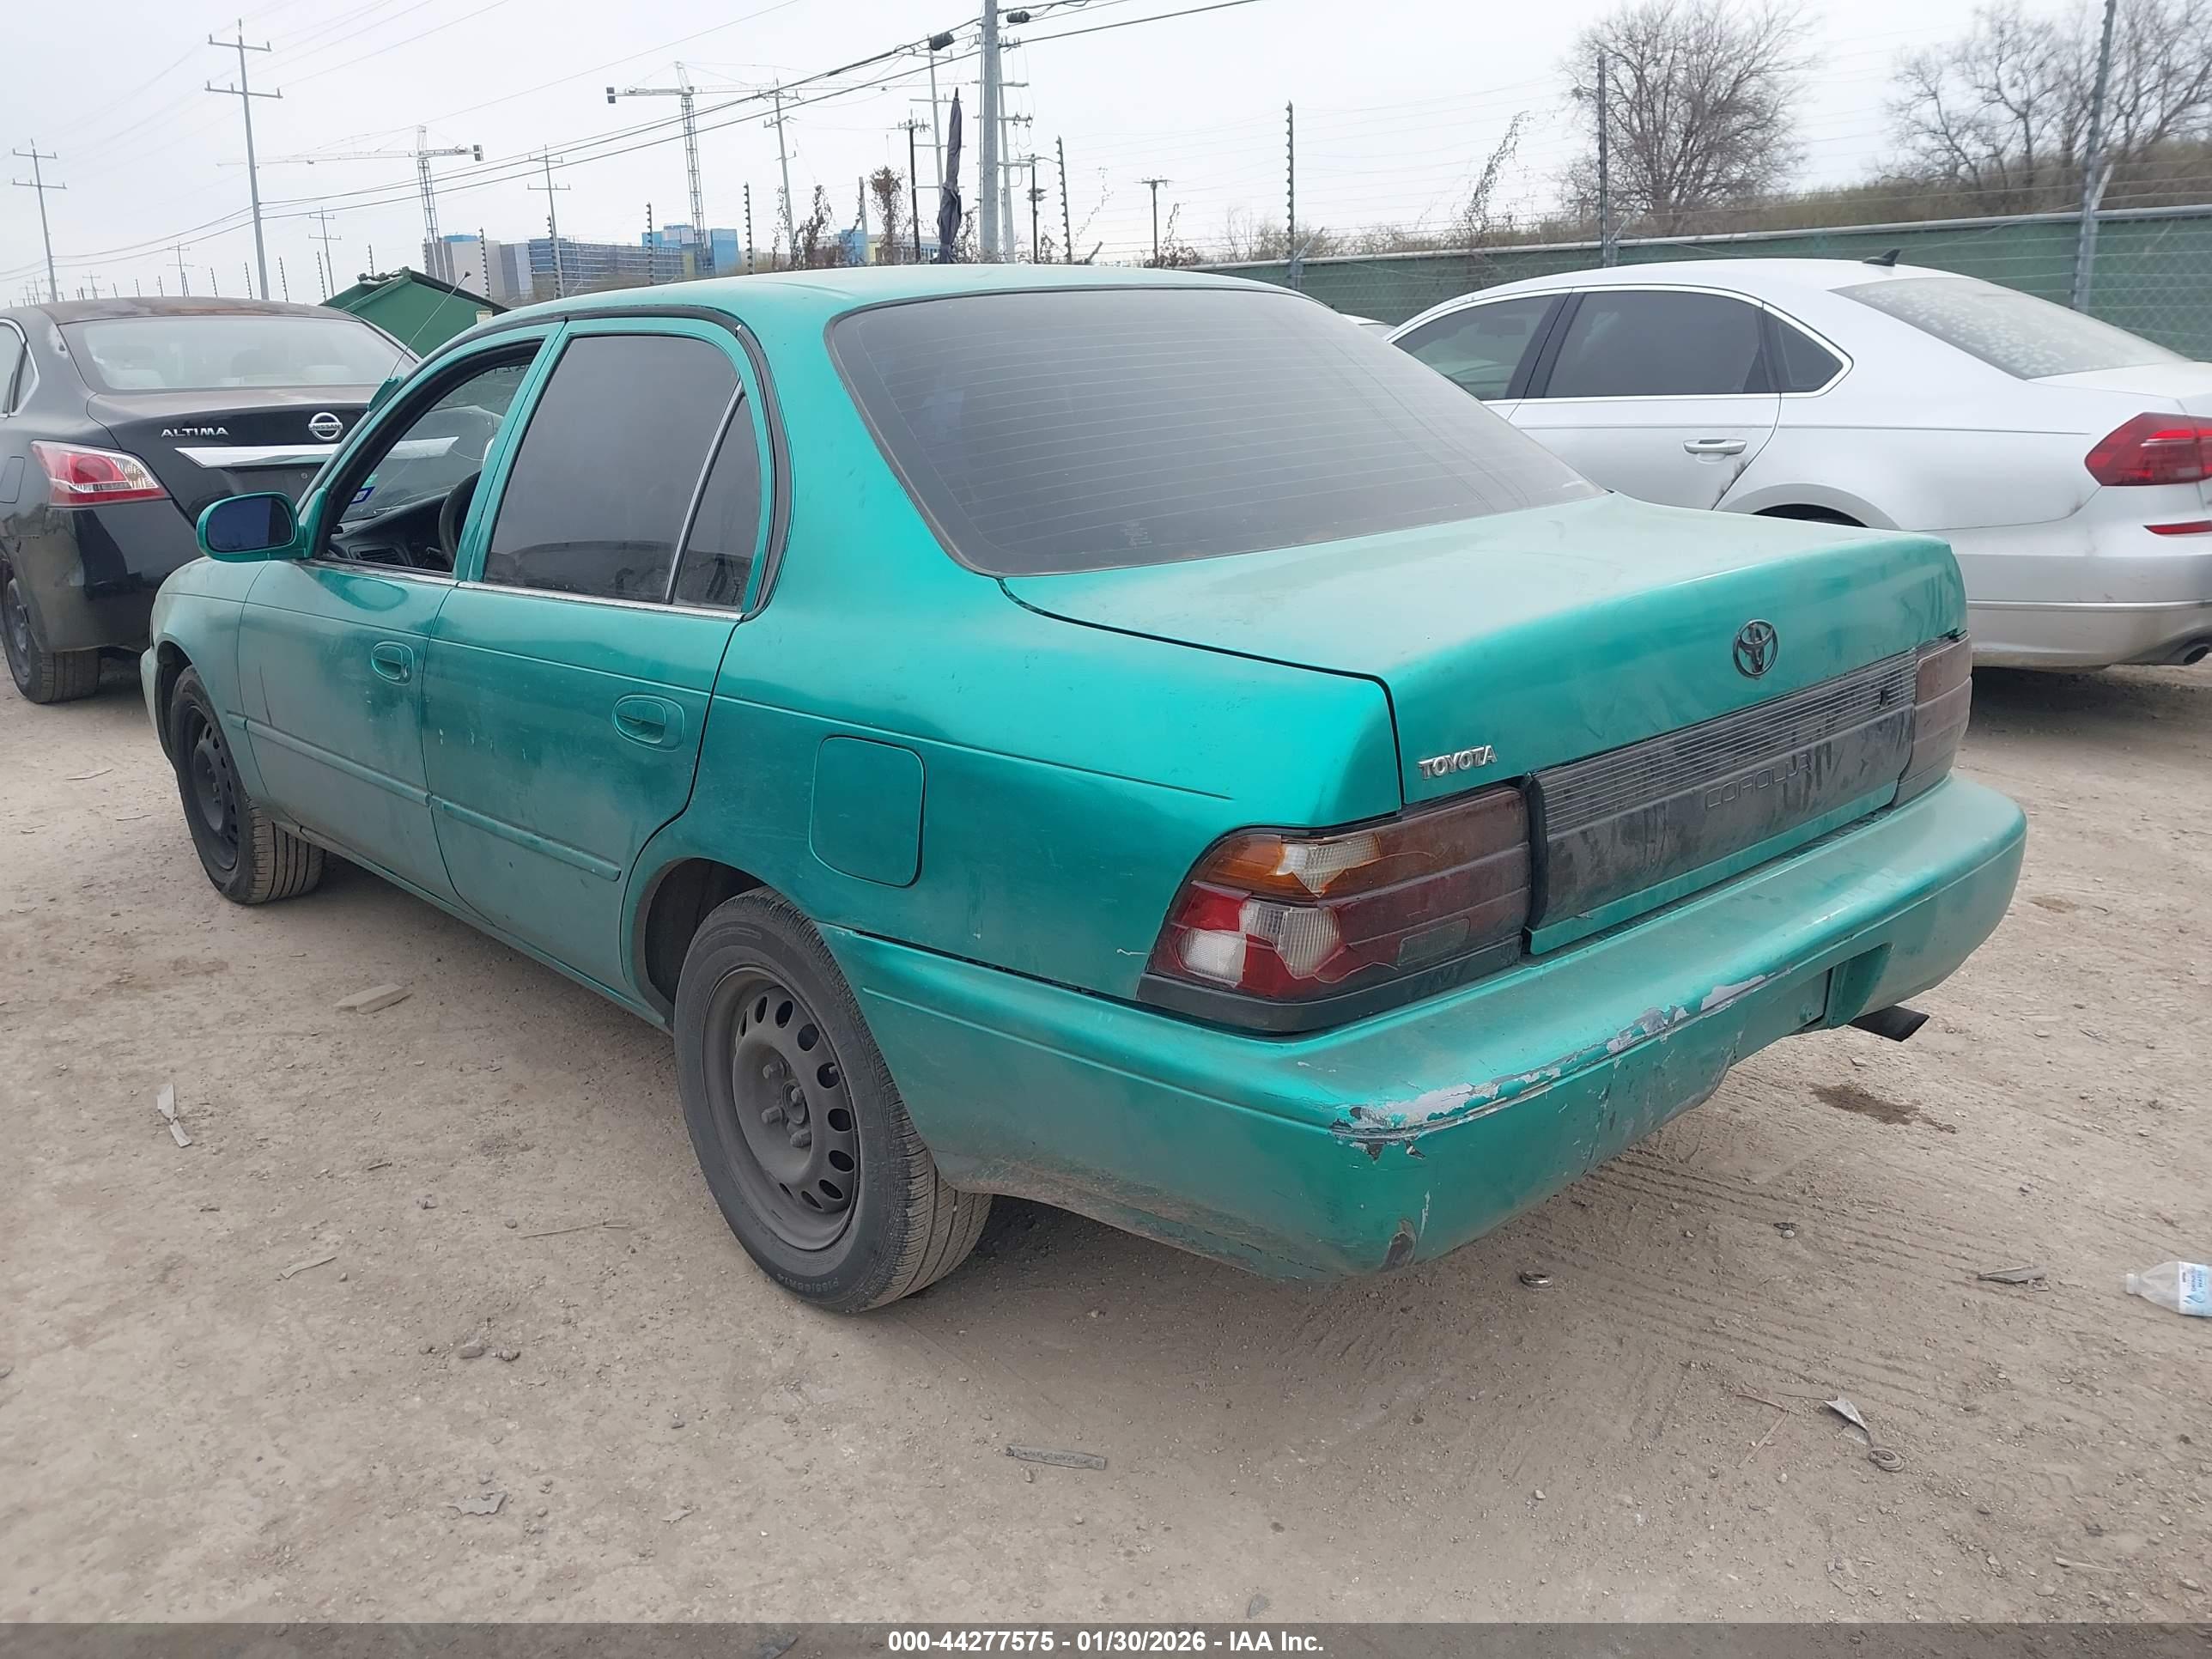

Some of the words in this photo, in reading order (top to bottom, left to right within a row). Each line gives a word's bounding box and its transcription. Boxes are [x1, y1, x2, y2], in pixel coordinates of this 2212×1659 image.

[161, 427, 229, 438] ALTIMA
[1418, 744, 1498, 779] TOYOTA
[1705, 753, 1813, 811] COROLLA
